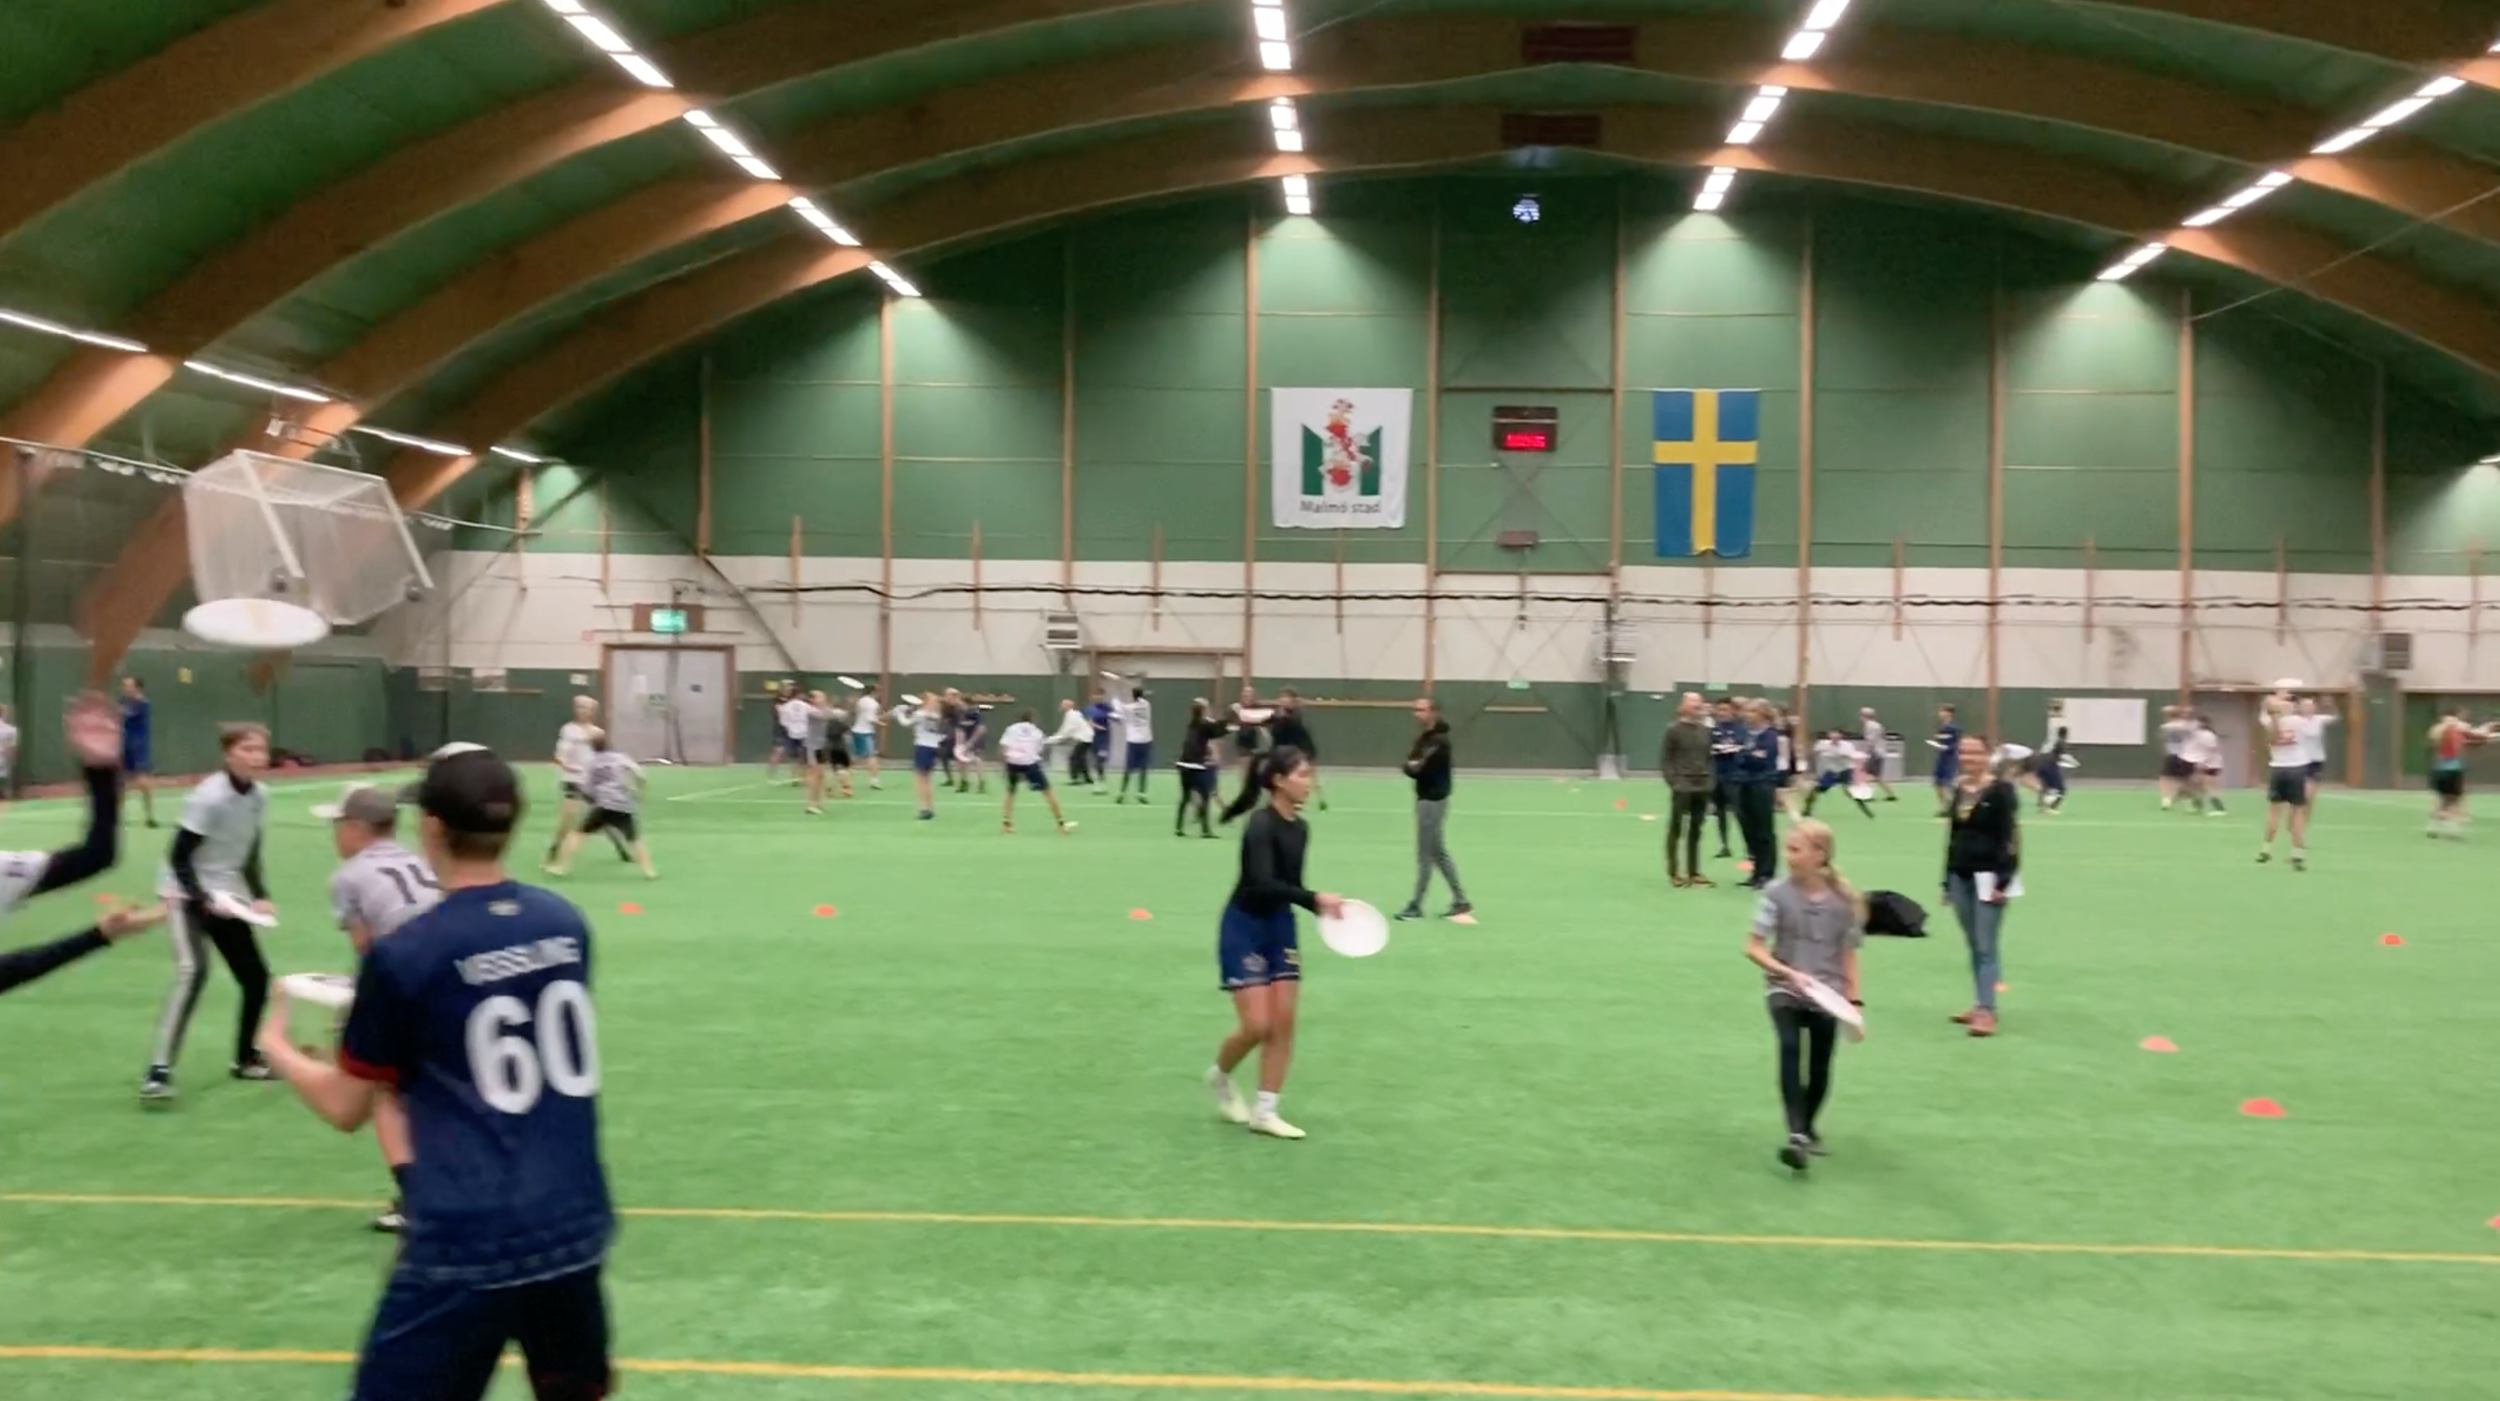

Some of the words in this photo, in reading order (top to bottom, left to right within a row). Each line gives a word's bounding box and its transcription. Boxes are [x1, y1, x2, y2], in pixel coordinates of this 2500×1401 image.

[1300, 500, 1347, 514] Malmö
[1352, 500, 1380, 513] stad
[464, 979, 602, 1115] 60
